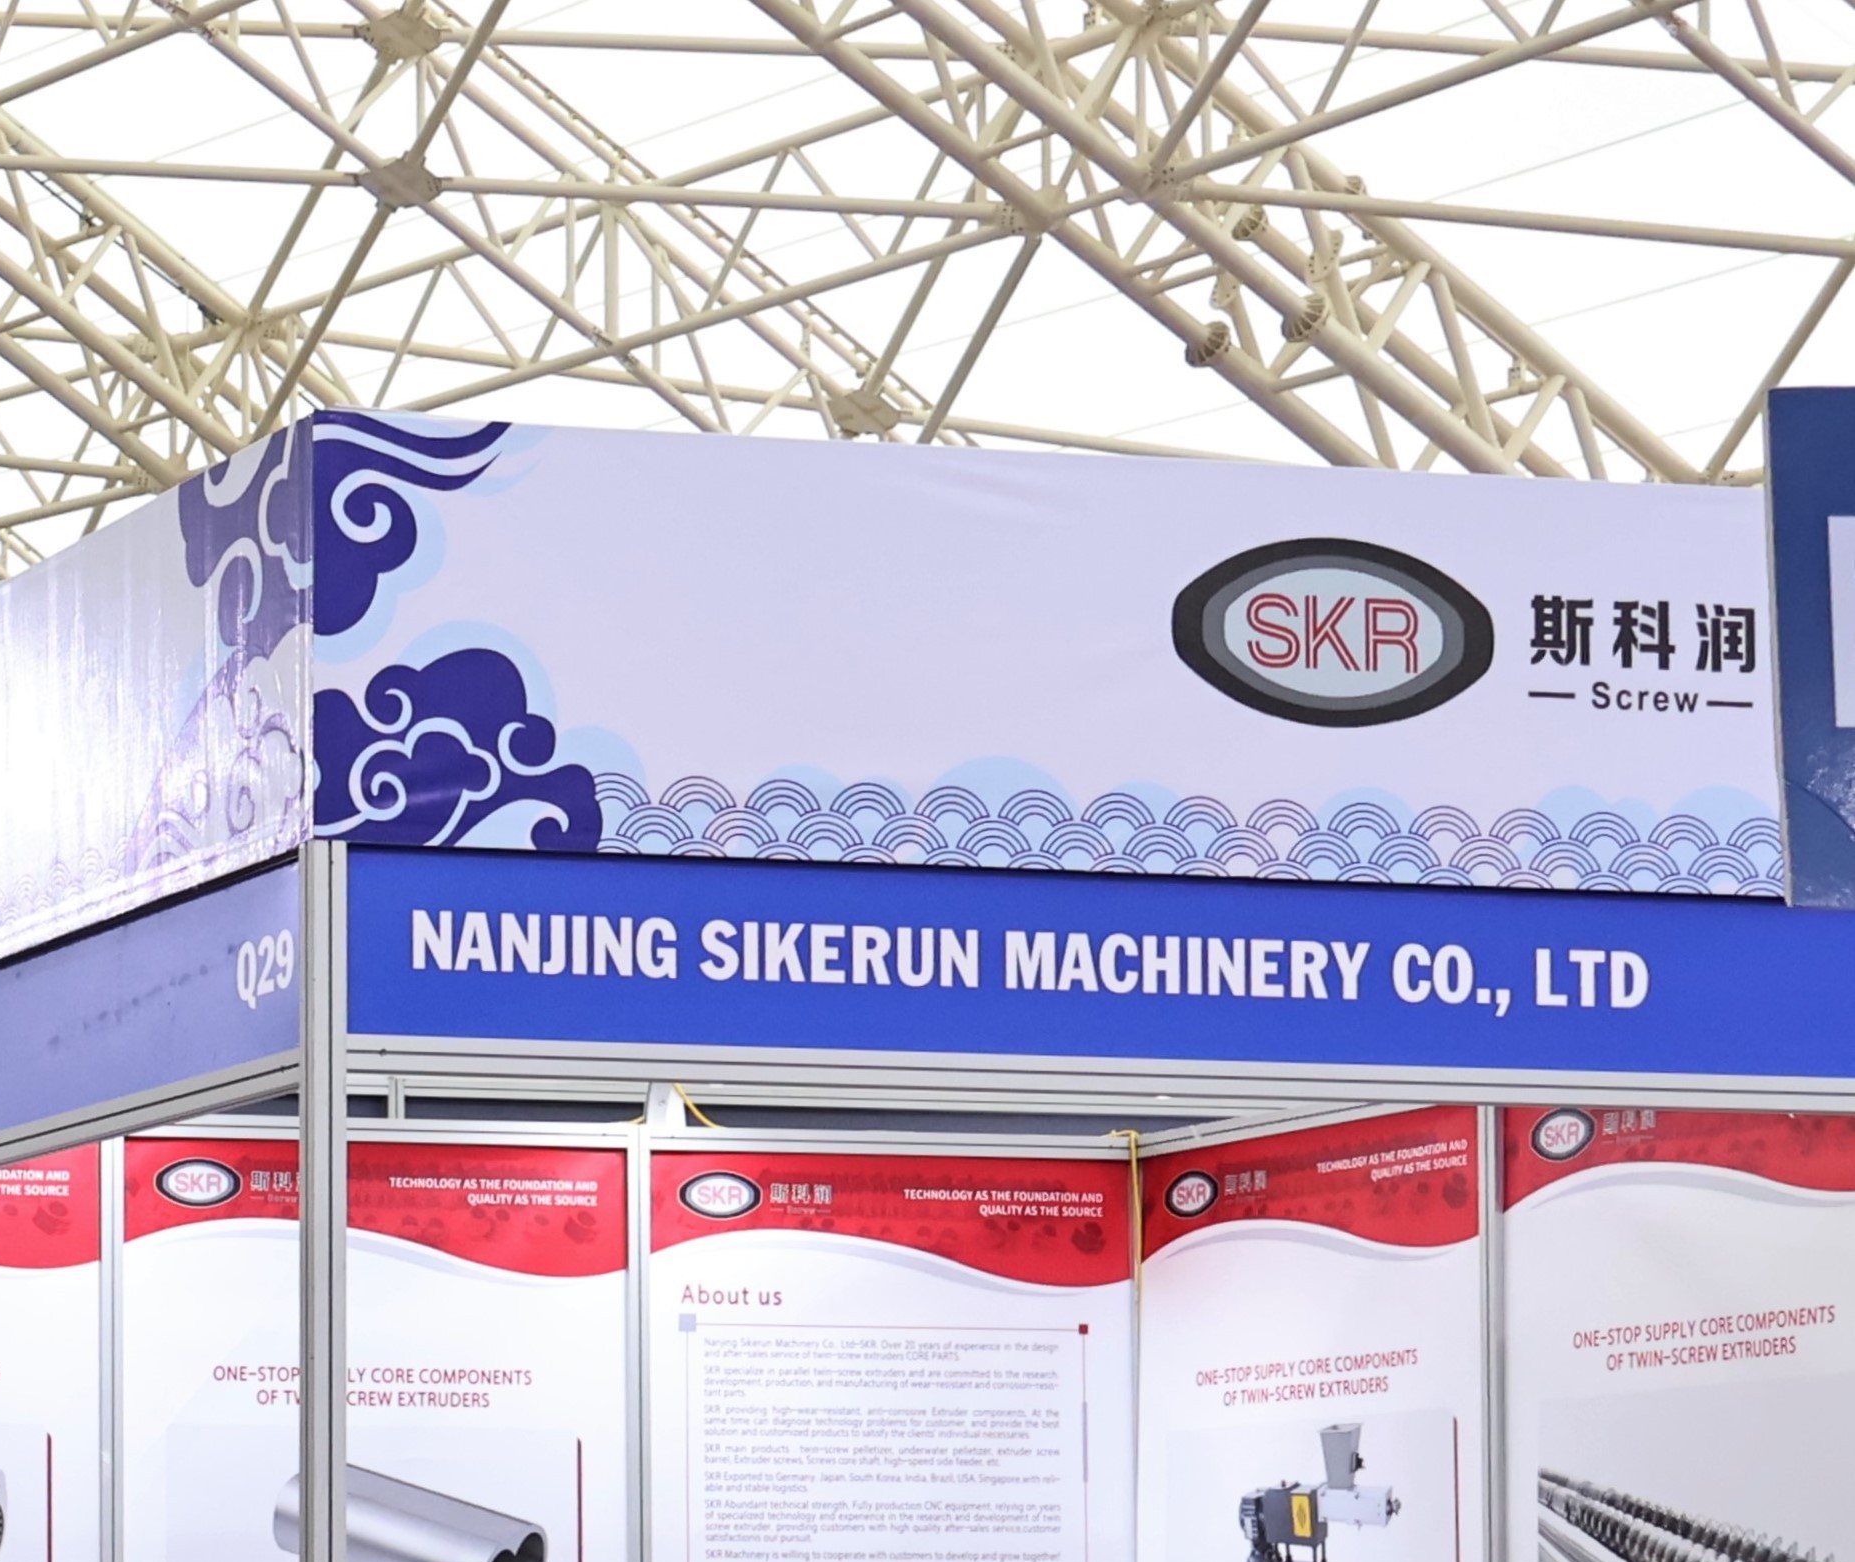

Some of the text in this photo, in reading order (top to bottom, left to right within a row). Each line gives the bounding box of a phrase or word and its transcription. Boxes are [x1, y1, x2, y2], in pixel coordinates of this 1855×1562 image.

[1246, 593, 1420, 674] SKR
[1530, 594, 1757, 673] 斯科润
[1590, 682, 1699, 713] Screw
[236, 928, 294, 1009] Q29
[412, 909, 1650, 1017] NANJING SIKERUN MACHINERY CO., LTD
[682, 1285, 783, 1306] About us
